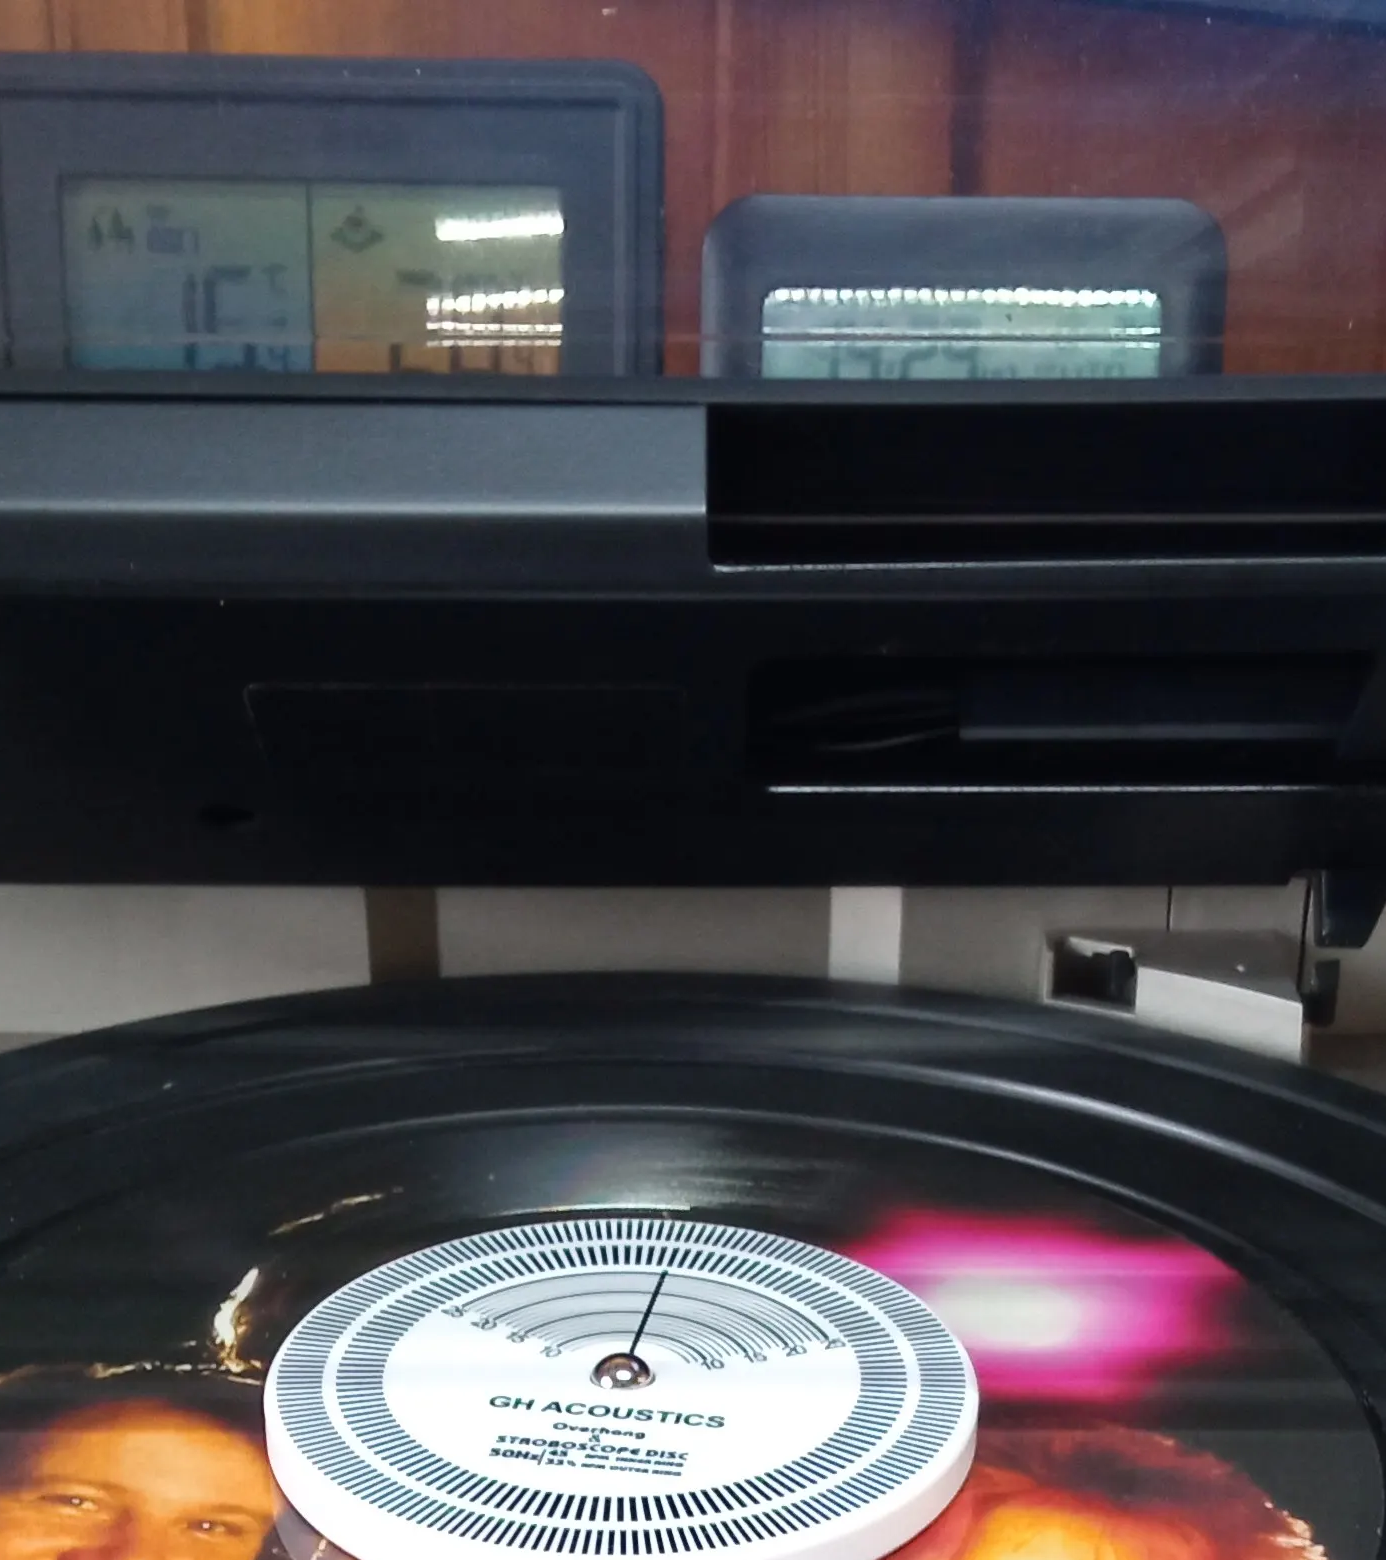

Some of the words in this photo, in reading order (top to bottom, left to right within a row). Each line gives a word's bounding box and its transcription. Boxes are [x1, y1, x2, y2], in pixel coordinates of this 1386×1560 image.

[701, 1358, 725, 1371] 10
[489, 1395, 536, 1411] GH
[541, 1401, 726, 1429] ACOUSTICS
[552, 1422, 646, 1440] Overhang
[496, 1434, 641, 1457] STROBOSCOPE
[645, 1449, 690, 1461] DISC
